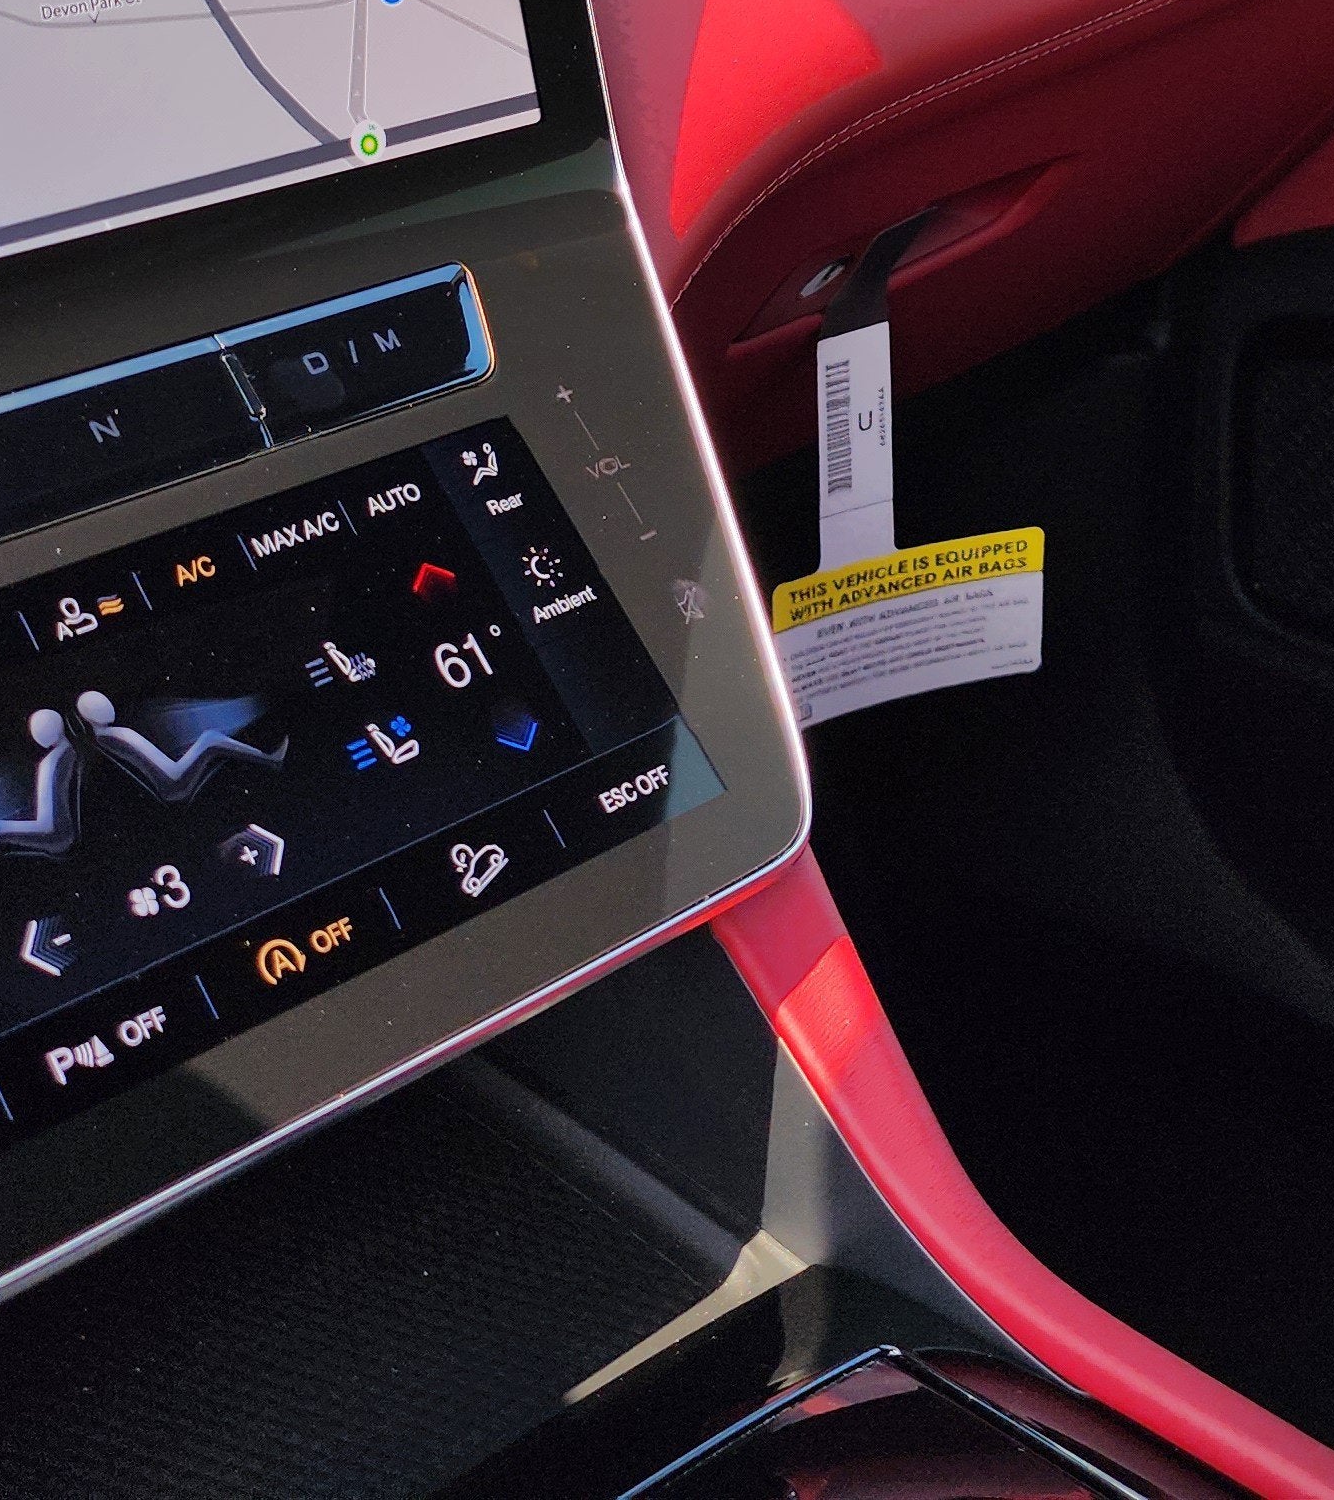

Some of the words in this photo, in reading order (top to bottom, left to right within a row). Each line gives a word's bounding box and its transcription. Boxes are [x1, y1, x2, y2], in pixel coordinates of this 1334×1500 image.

[41, 1, 88, 20] Devon
[372, 329, 402, 354] M
[89, 414, 121, 445] N
[586, 455, 631, 479] VOL
[367, 483, 421, 518] AUTO
[485, 492, 524, 517] Rear
[250, 523, 303, 559] MAX
[302, 511, 341, 541] A/C
[175, 556, 217, 588] A/C
[788, 582, 828, 604] THIS
[832, 559, 908, 591] VEHICLE
[912, 554, 930, 571] IS
[935, 539, 1029, 566] EQUIPPED
[790, 600, 834, 622] WITH
[839, 573, 937, 606] ADVANCED
[942, 565, 973, 583] AIR
[978, 557, 1028, 574] BAGS
[532, 584, 598, 624] Ambient
[598, 778, 639, 815] ESC
[635, 764, 670, 797] OFF
[153, 864, 190, 910] 3
[309, 917, 354, 954] OFF
[116, 1005, 167, 1048] OFF
